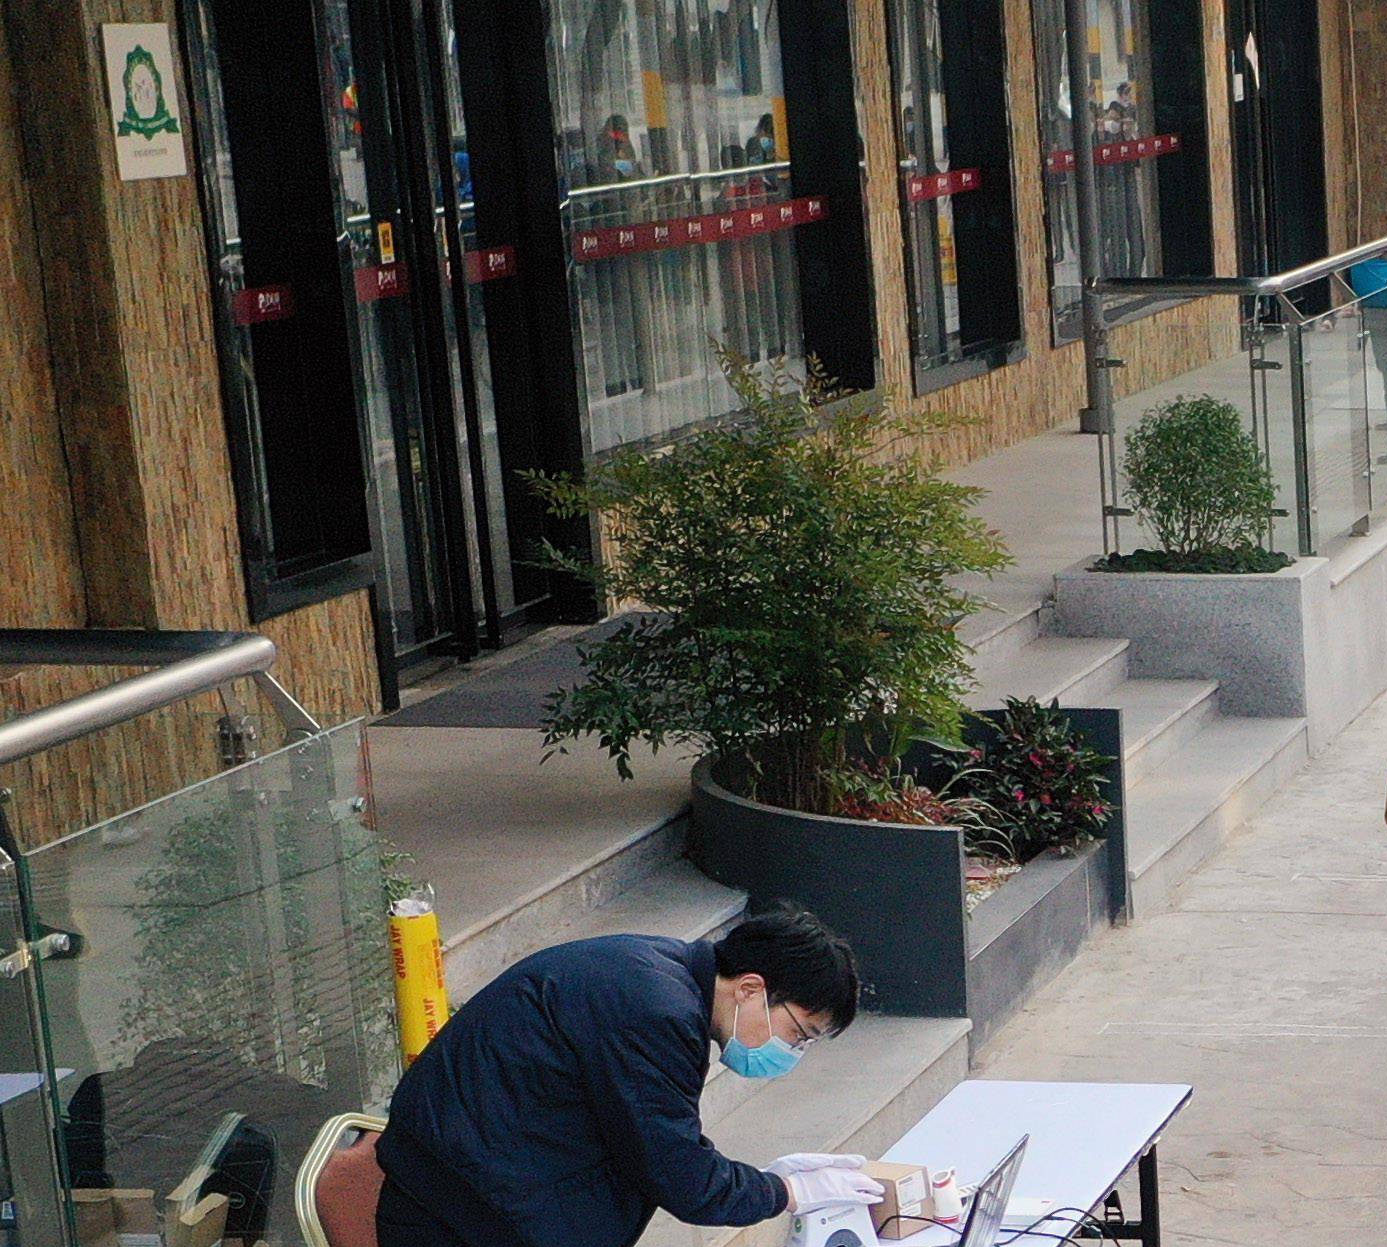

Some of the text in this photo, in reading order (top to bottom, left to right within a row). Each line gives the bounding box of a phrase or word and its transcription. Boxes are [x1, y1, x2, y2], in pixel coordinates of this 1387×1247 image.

[391, 925, 407, 980] JAY WRAP
[423, 998, 436, 1017] JAY
